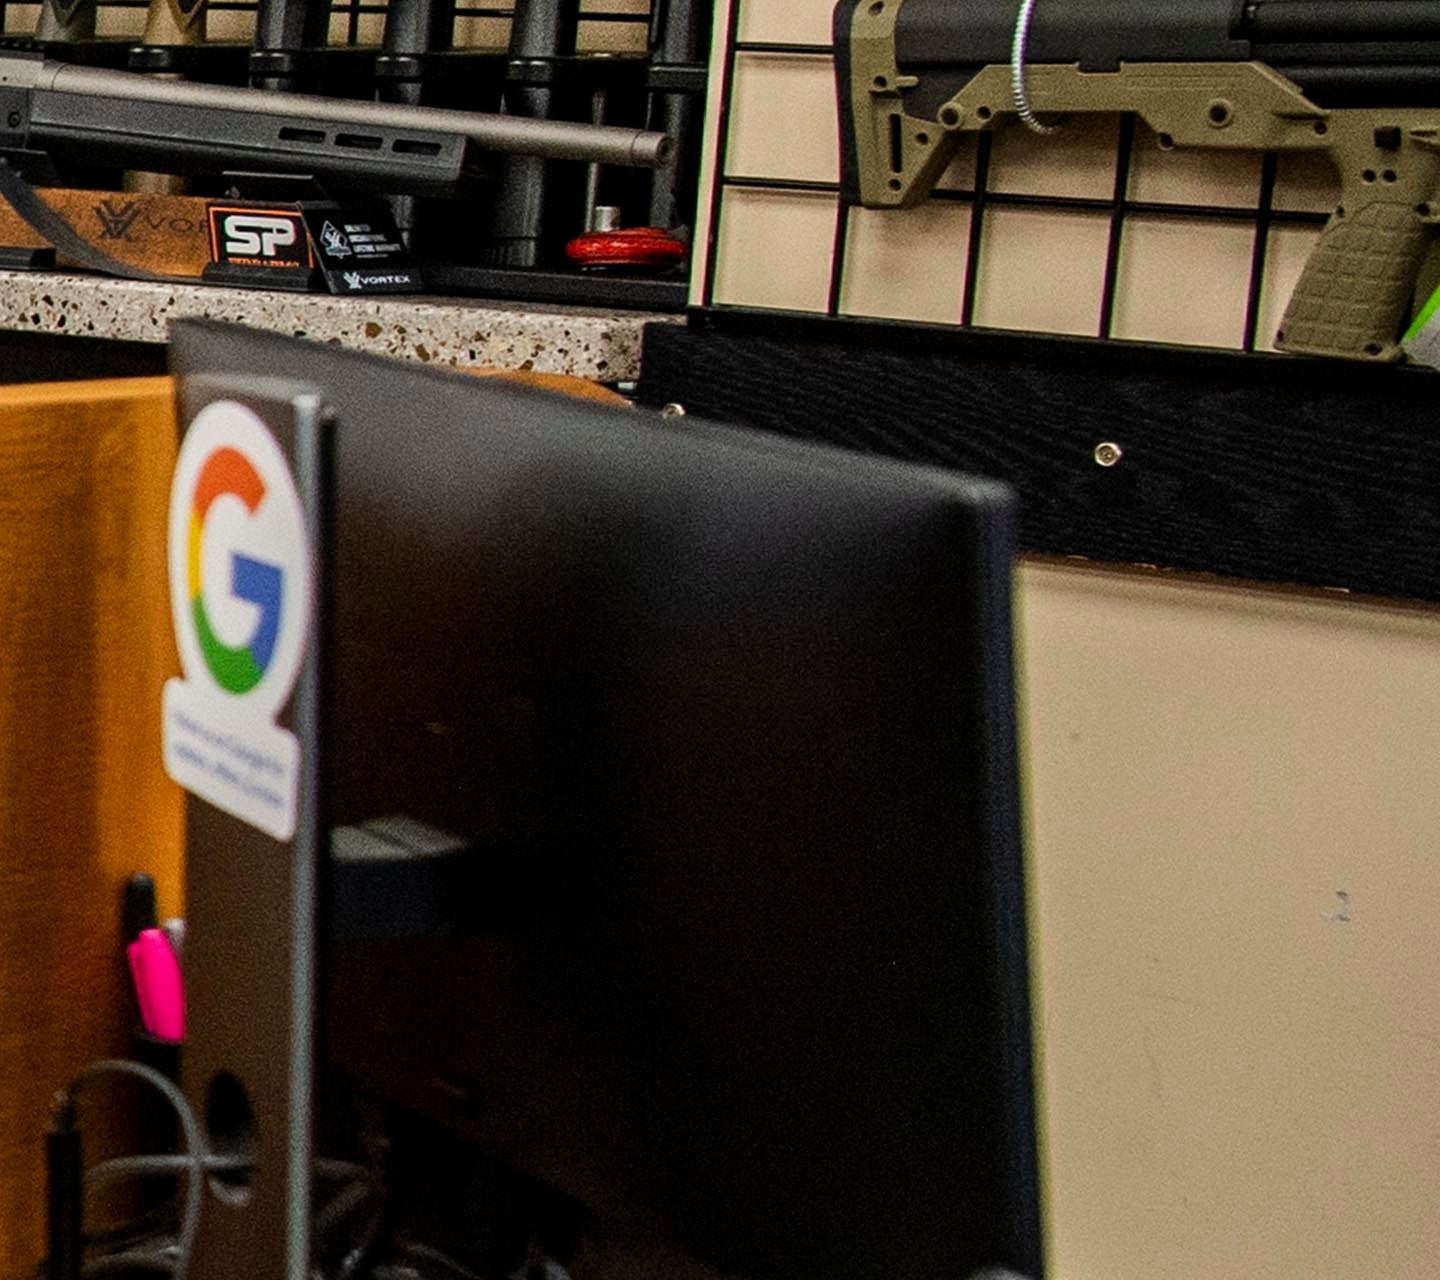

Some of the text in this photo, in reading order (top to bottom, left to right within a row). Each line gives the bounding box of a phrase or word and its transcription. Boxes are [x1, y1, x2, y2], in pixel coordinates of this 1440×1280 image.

[224, 215, 296, 257] SP
[360, 274, 411, 285] VORTEX
[187, 446, 284, 696] G
